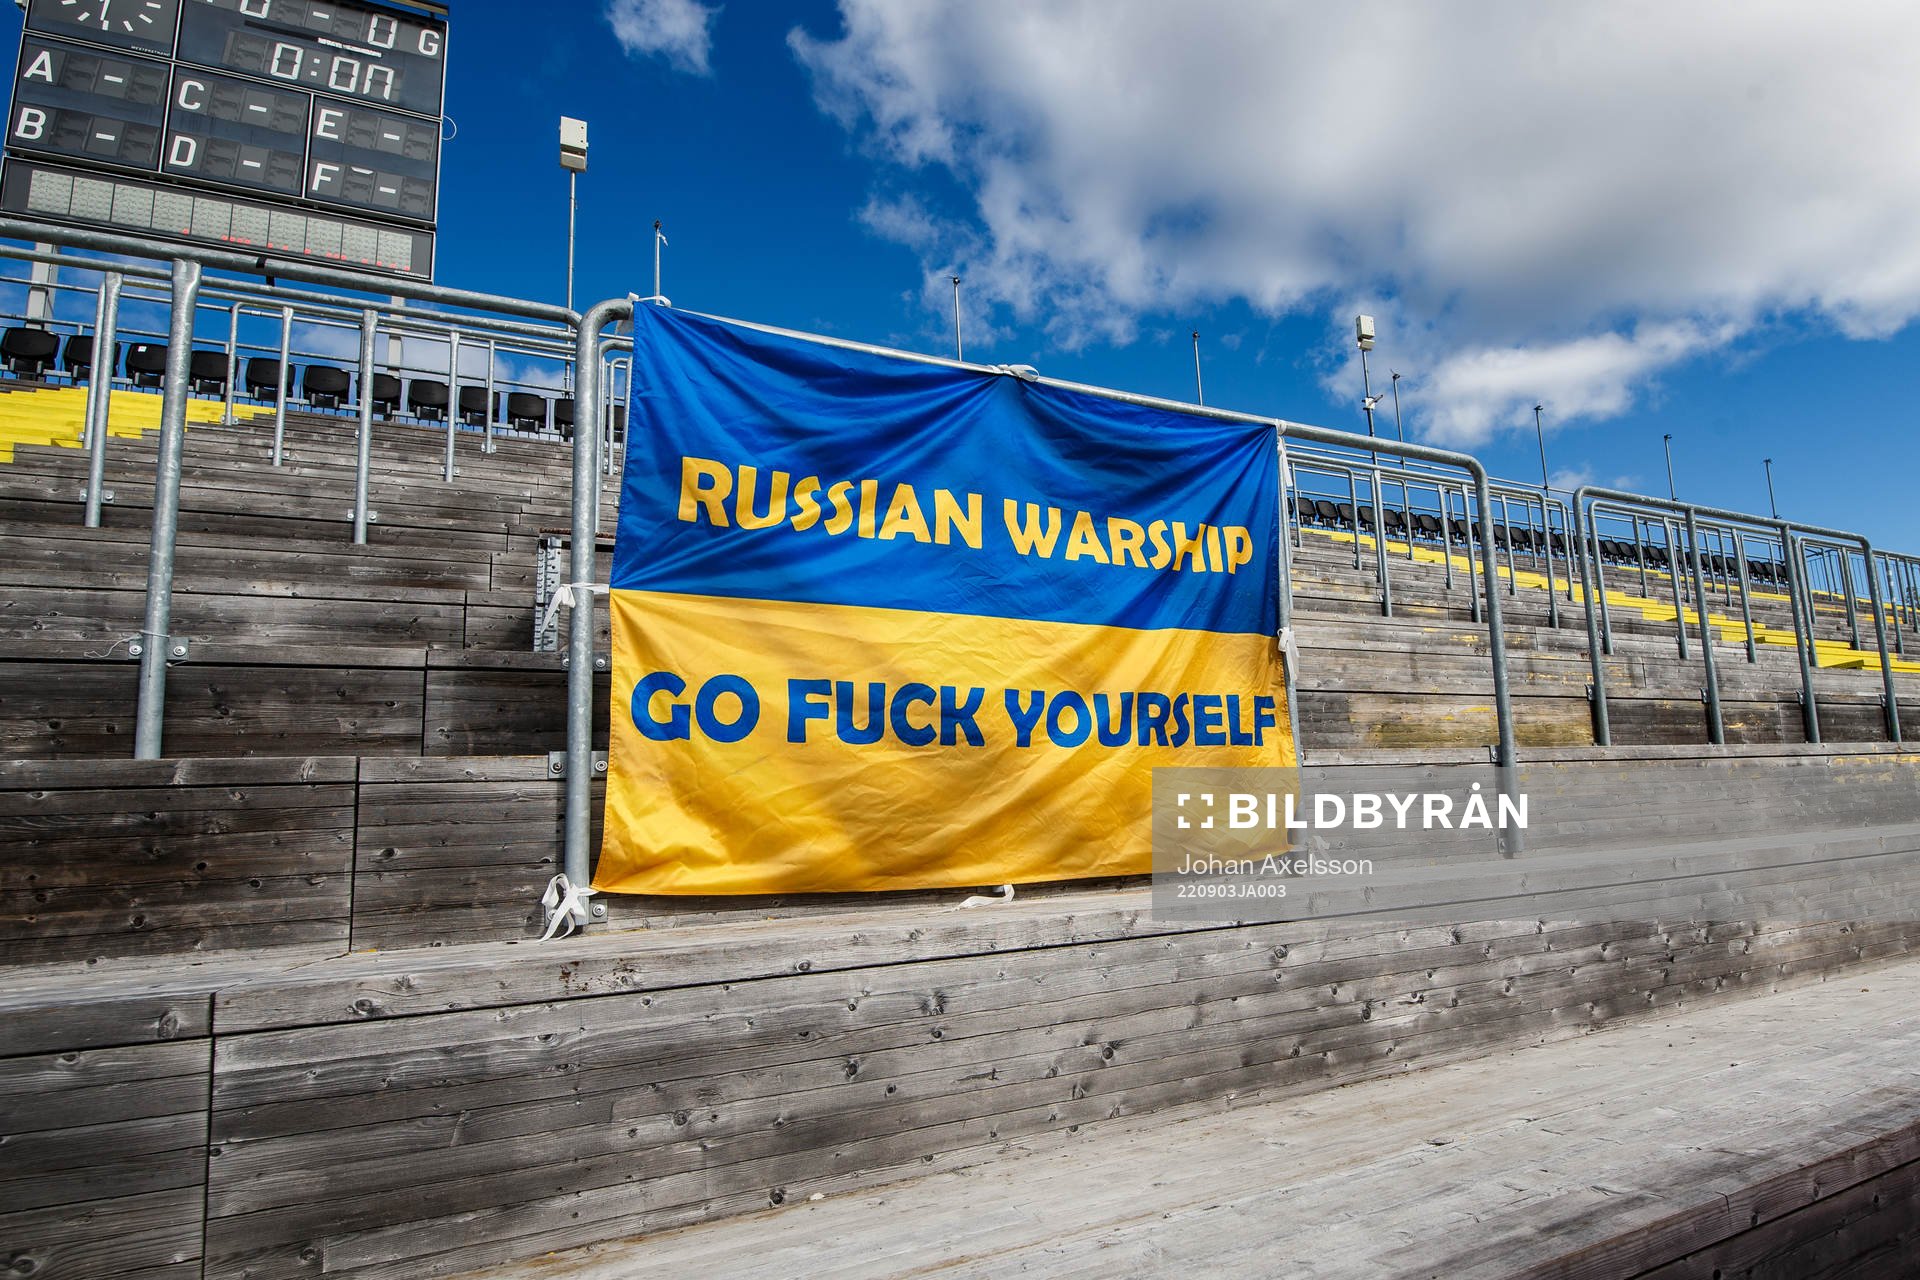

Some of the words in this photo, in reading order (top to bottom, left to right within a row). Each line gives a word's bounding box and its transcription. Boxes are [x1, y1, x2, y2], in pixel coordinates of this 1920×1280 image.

[418, 29, 440, 56] G
[24, 51, 53, 82] A
[178, 80, 205, 110] C
[15, 107, 46, 140] B
[316, 108, 343, 139] E
[169, 135, 197, 167] D
[312, 162, 340, 191] F
[678, 457, 983, 549] RUSSIAN
[1003, 499, 1253, 575] WARSHIP
[630, 671, 760, 743] GO
[786, 678, 985, 746] FUCK
[1004, 688, 1276, 748] YOURSELF
